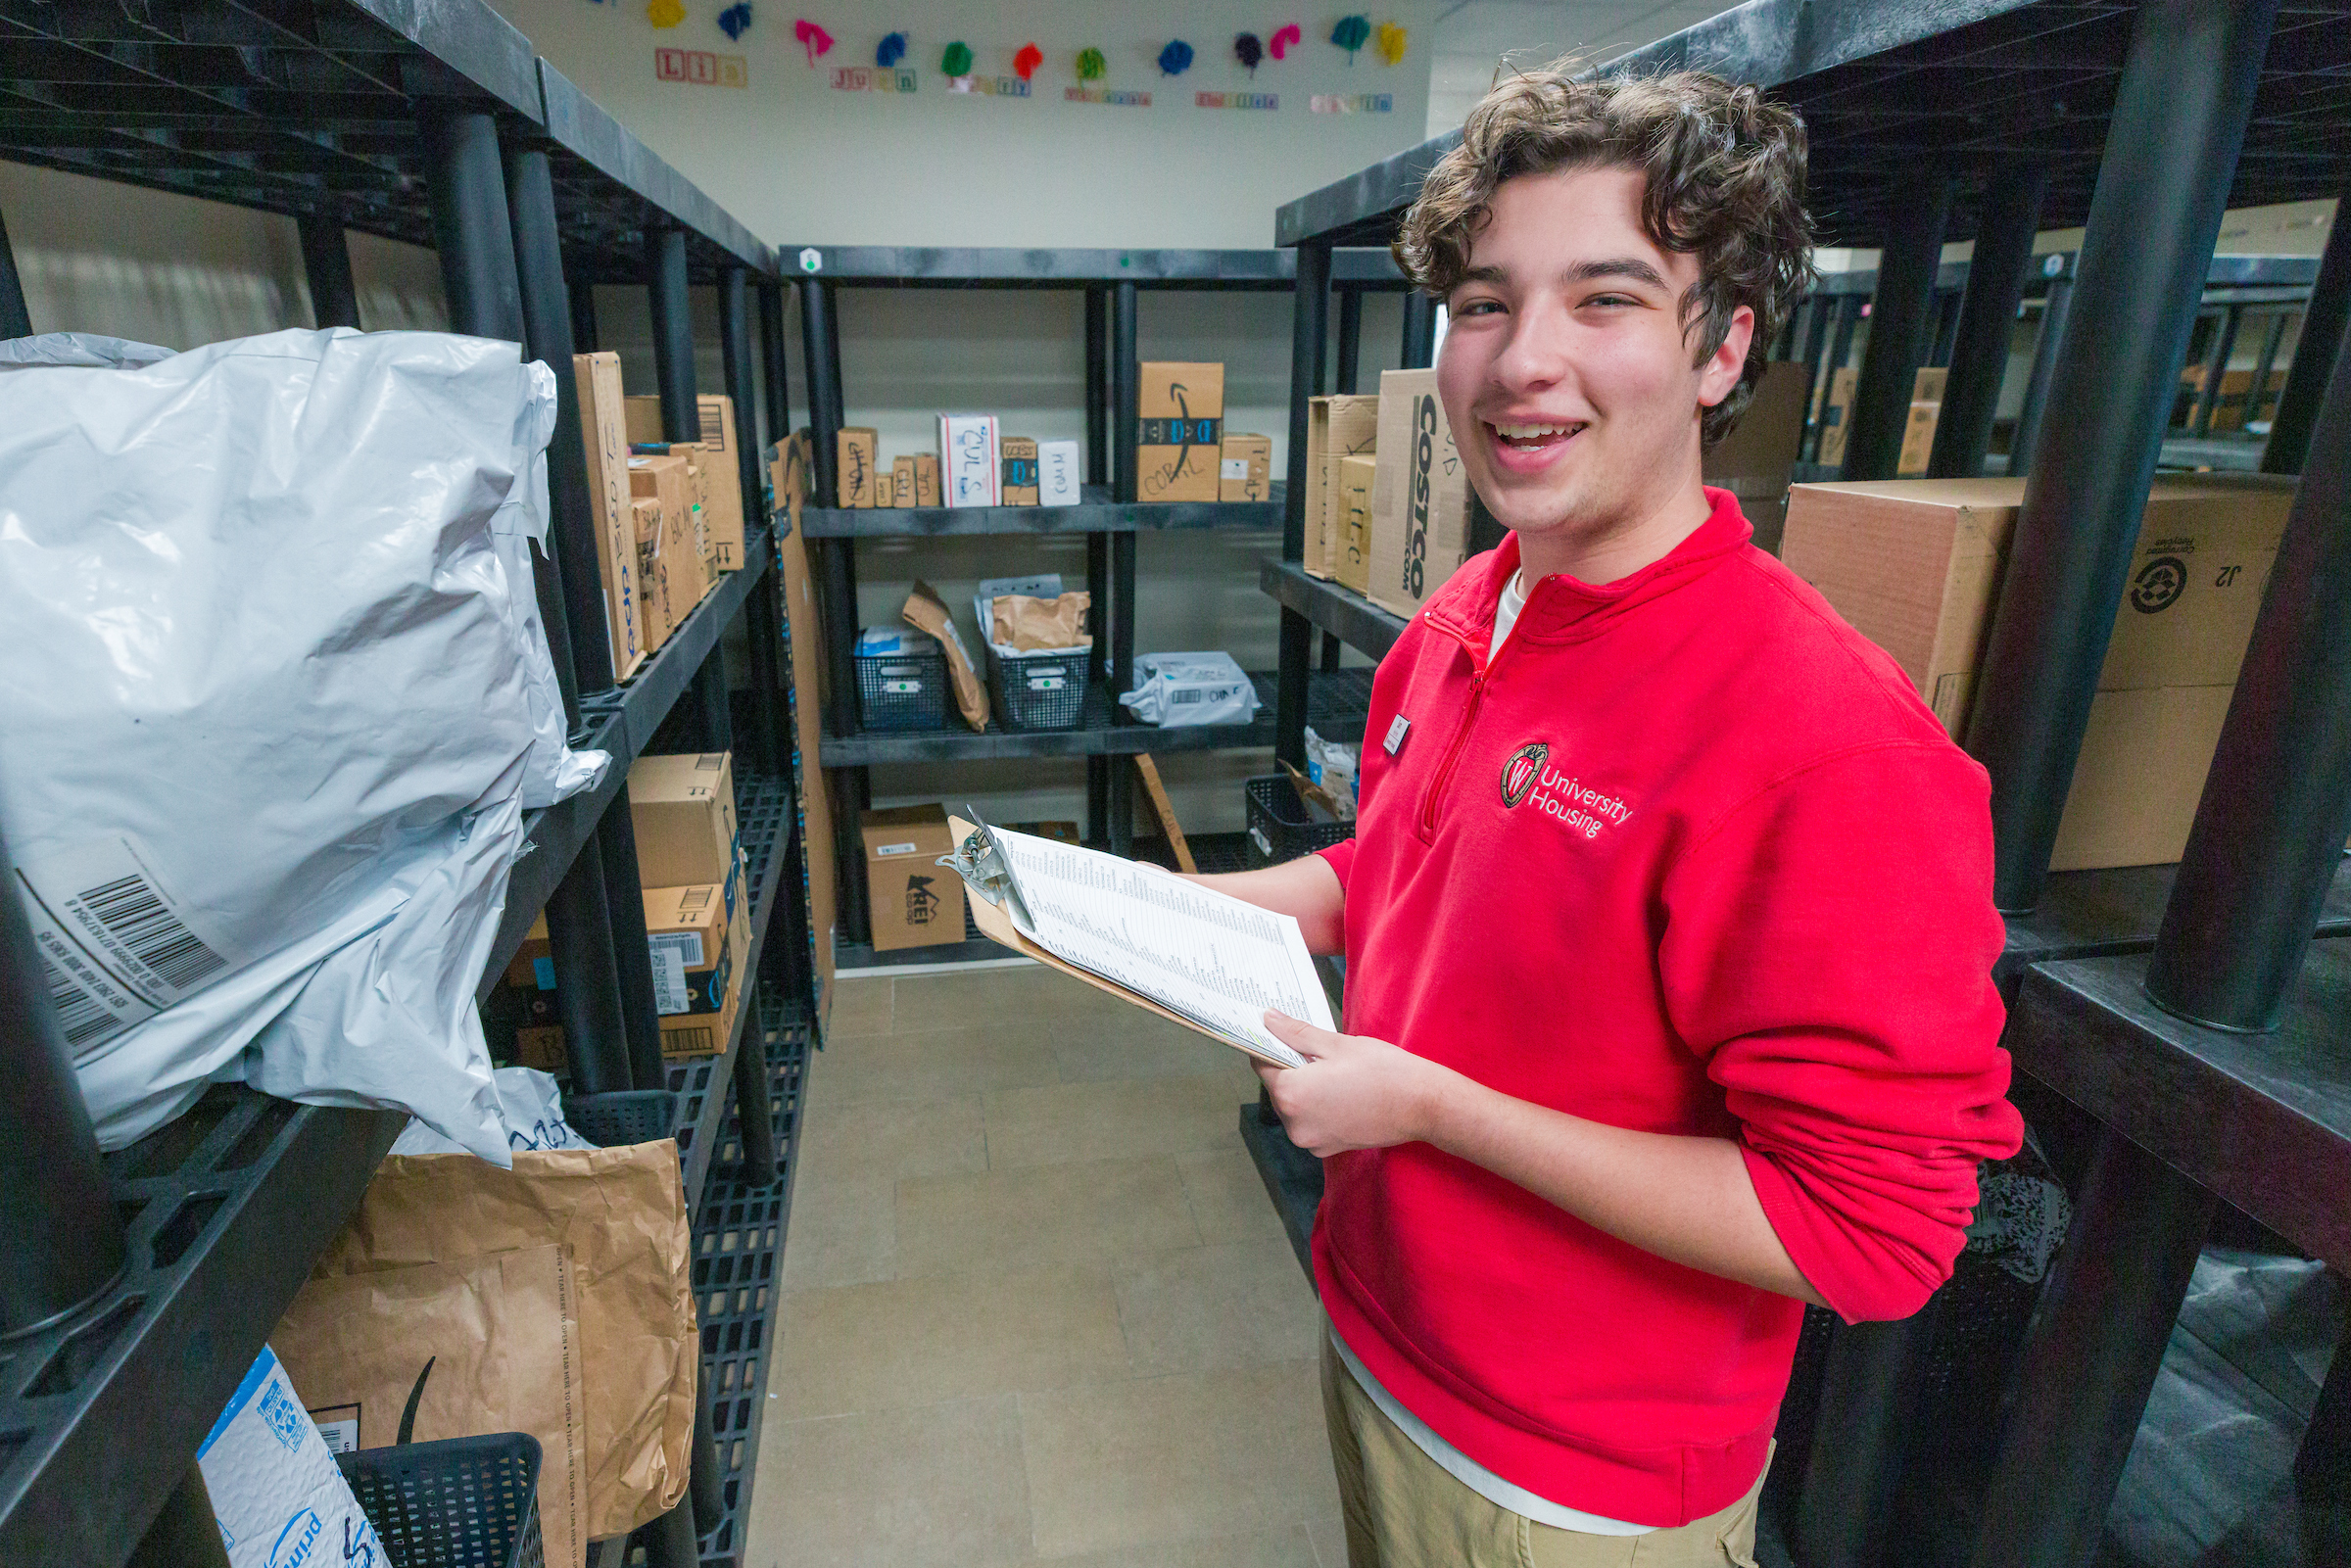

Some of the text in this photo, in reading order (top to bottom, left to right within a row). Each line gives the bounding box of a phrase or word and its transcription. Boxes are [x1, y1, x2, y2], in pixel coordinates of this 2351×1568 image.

[1410, 394, 1437, 599] COSTCO
[2215, 565, 2242, 587] J2
[1508, 759, 1534, 794] W
[1528, 785, 1604, 839] Housing
[1540, 765, 1633, 826] University
[914, 892, 929, 924] REI
[266, 1388, 275, 1401] BAG
[266, 1387, 283, 1412] PLASTIC
[560, 1312, 567, 1323] TO
[564, 1391, 571, 1401] TO
[568, 1469, 575, 1480] TO
[572, 1549, 578, 1559] TO
